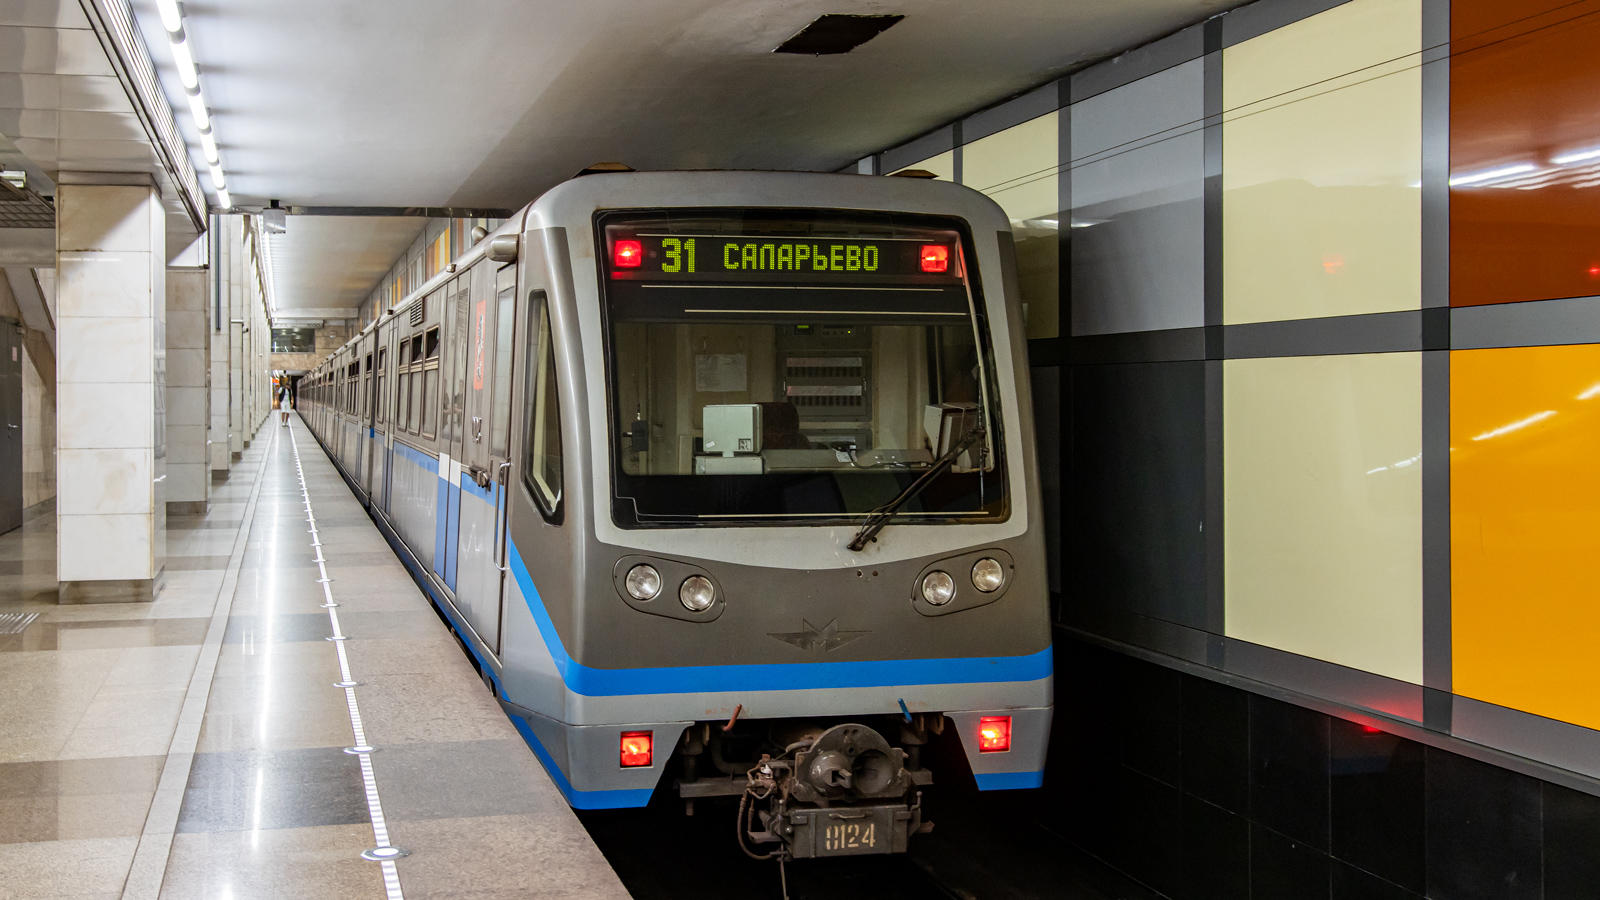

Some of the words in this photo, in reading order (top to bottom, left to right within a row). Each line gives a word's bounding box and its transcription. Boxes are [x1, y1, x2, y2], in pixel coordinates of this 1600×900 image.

[661, 238, 695, 273] 31
[723, 243, 879, 272] САЛАРЬЕВО
[826, 823, 876, 851] 0124
